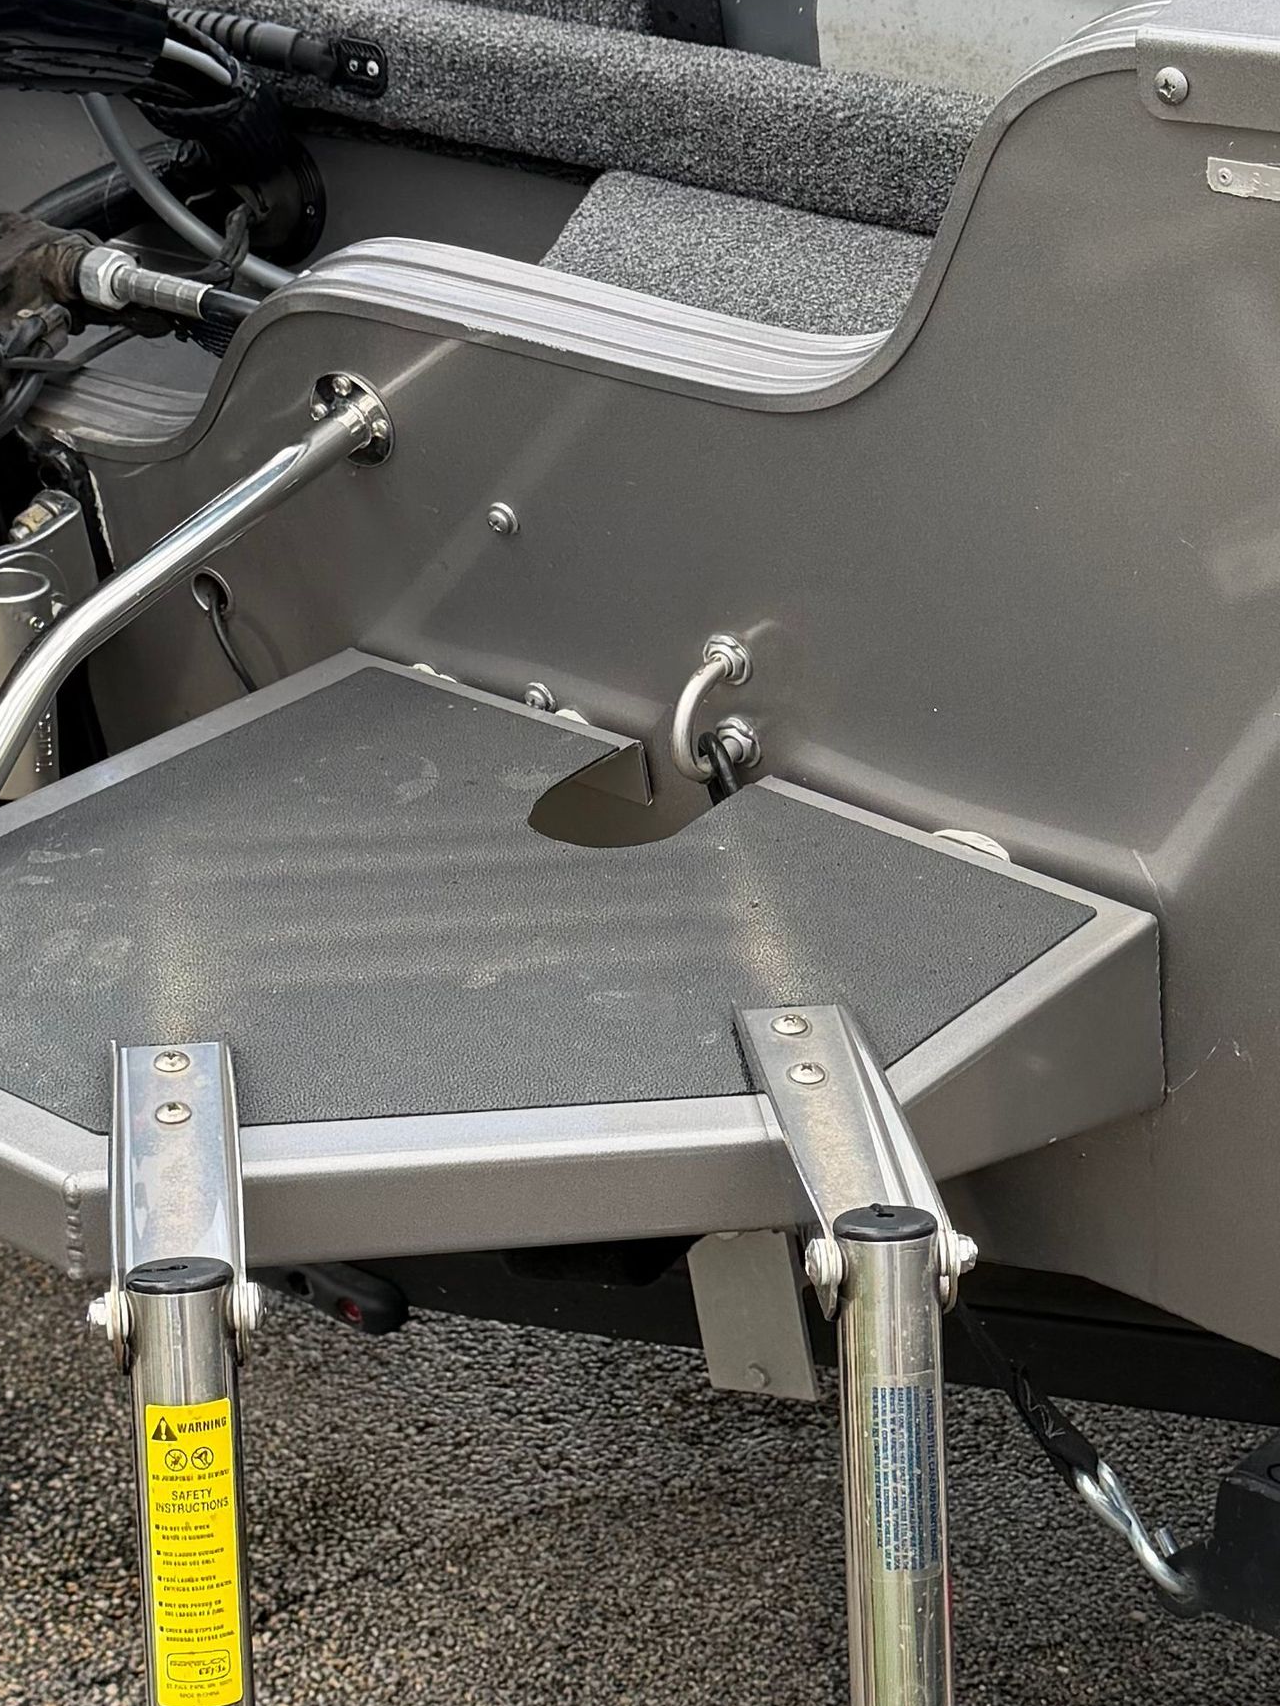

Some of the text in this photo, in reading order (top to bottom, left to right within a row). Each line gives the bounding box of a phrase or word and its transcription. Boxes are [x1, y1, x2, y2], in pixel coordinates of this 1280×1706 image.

[177, 1416, 227, 1433] WARNING
[171, 1487, 213, 1501] SAFETY
[155, 1496, 229, 1514] INSTRUCTIONS
